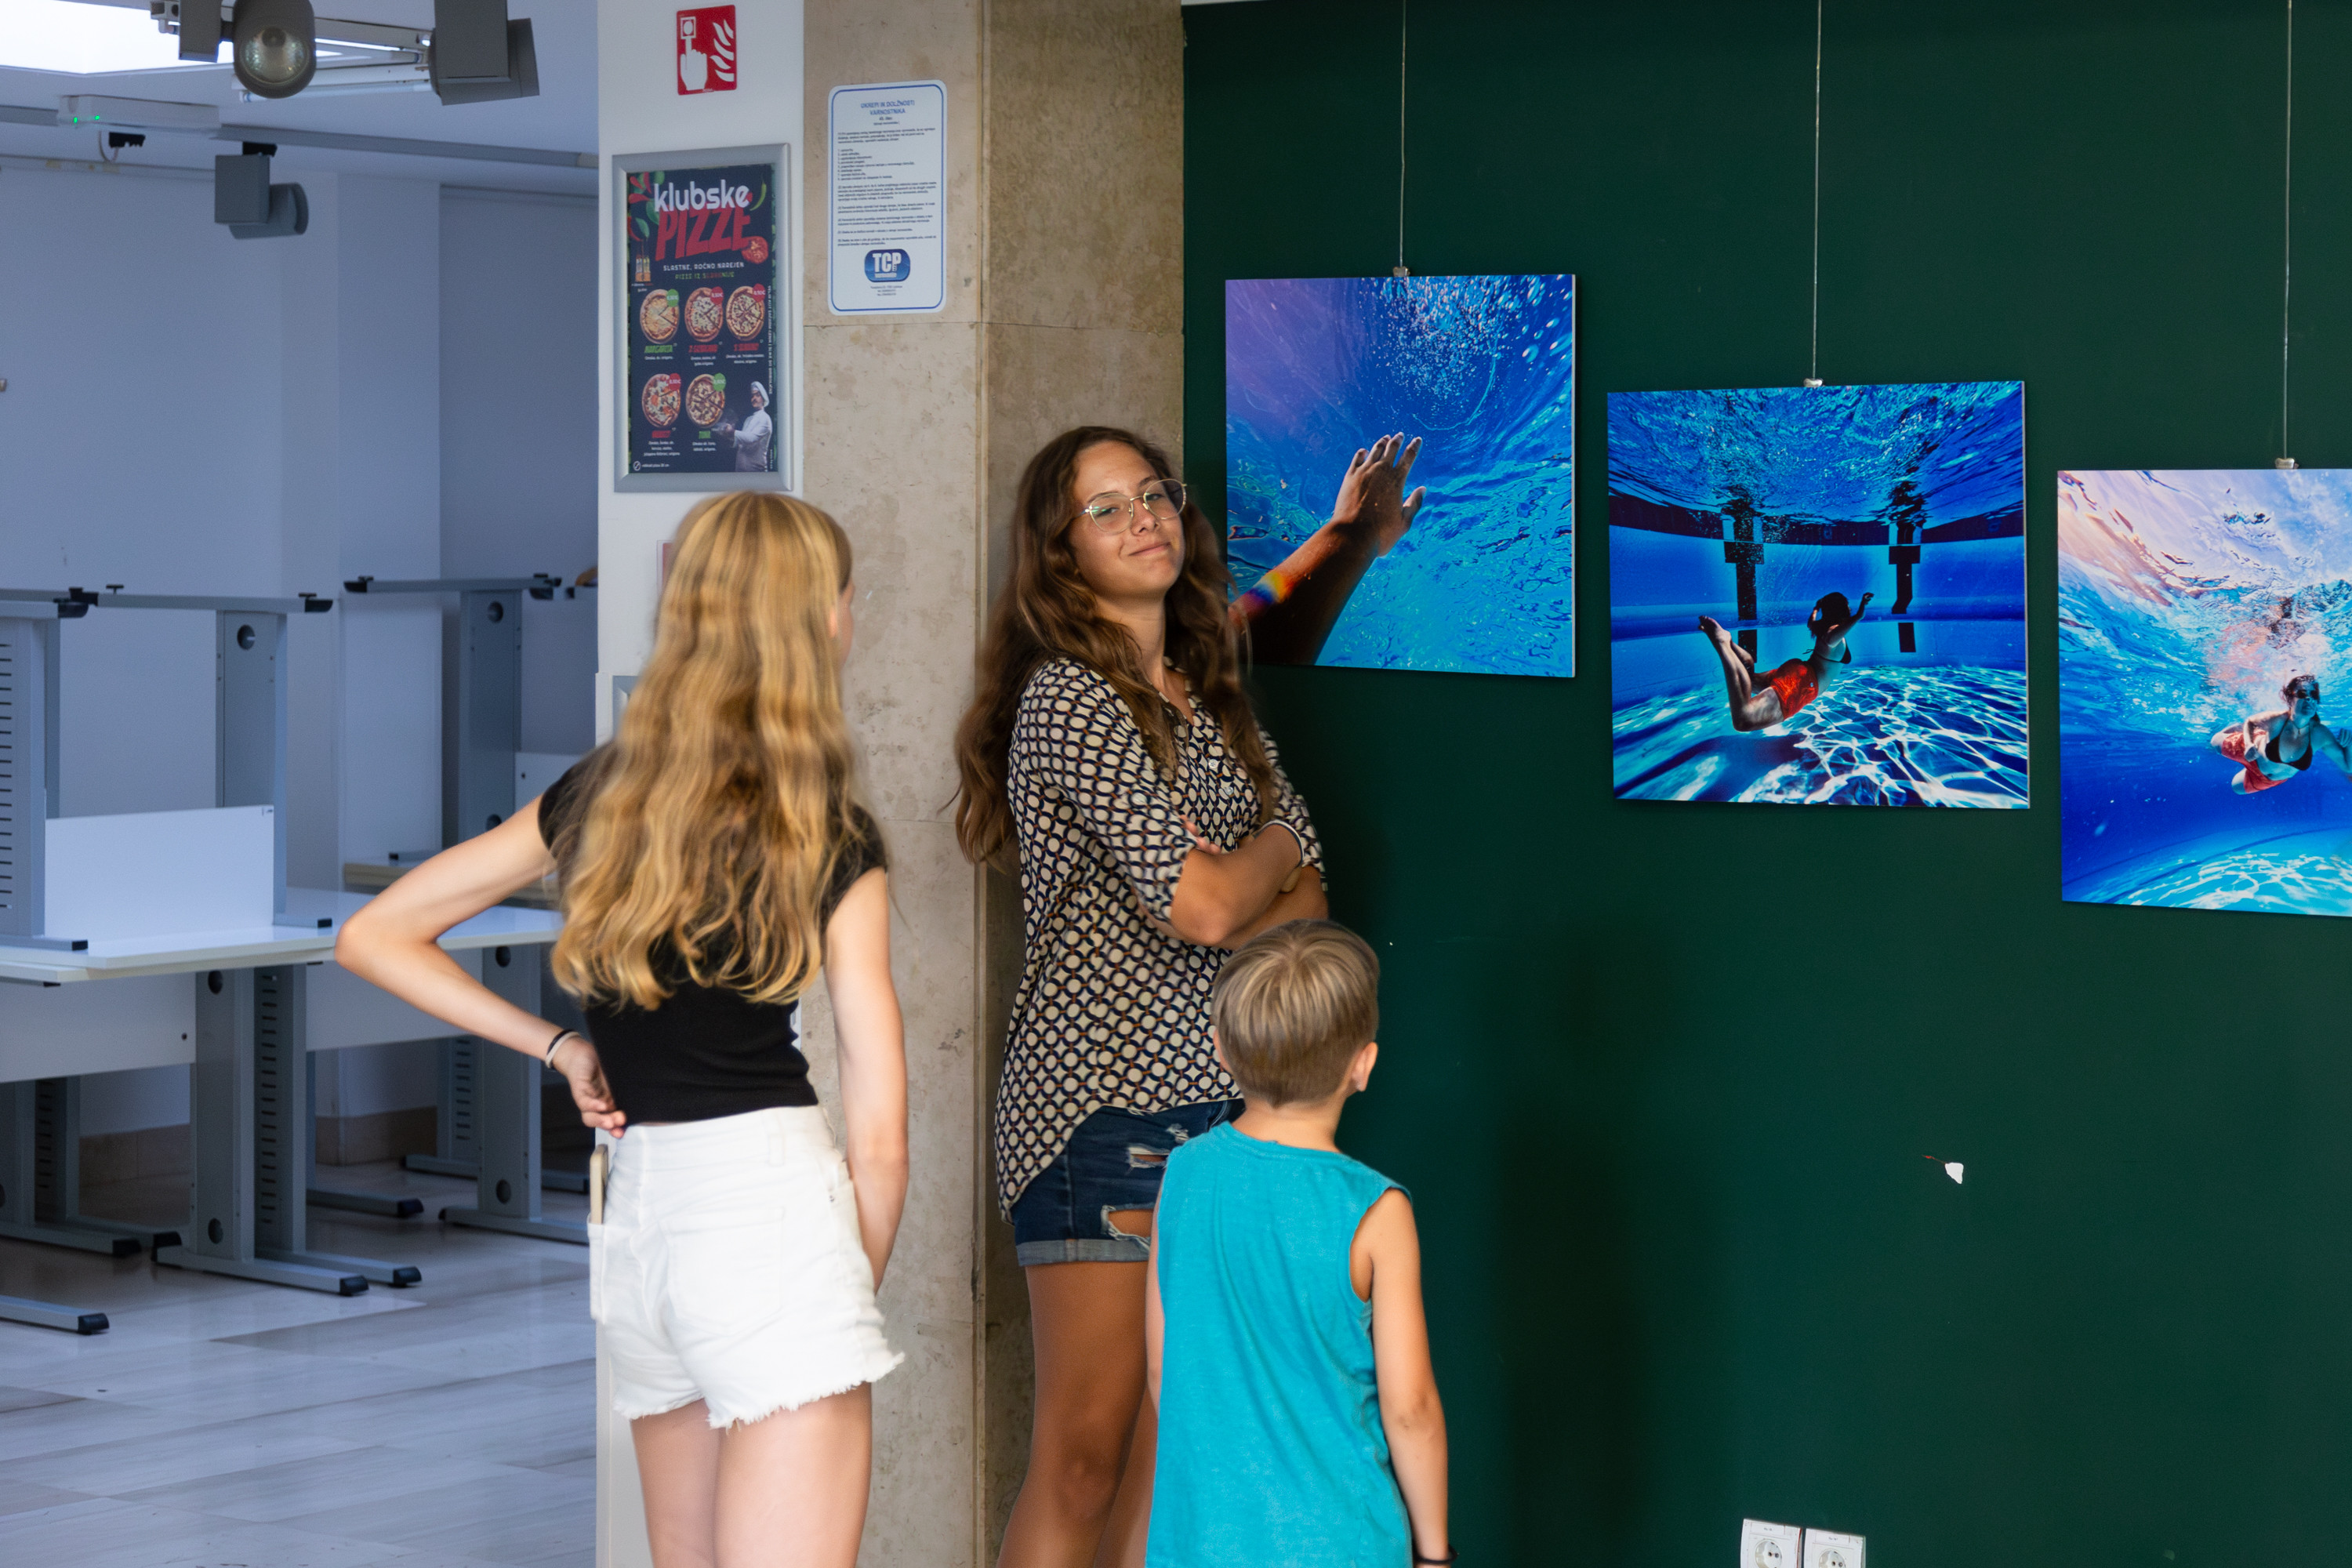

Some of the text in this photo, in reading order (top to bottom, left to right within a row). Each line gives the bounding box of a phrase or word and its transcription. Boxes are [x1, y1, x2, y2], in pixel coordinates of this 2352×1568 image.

[654, 179, 750, 212] klubske
[655, 201, 750, 262] PIZZE
[872, 252, 902, 273] TCP
